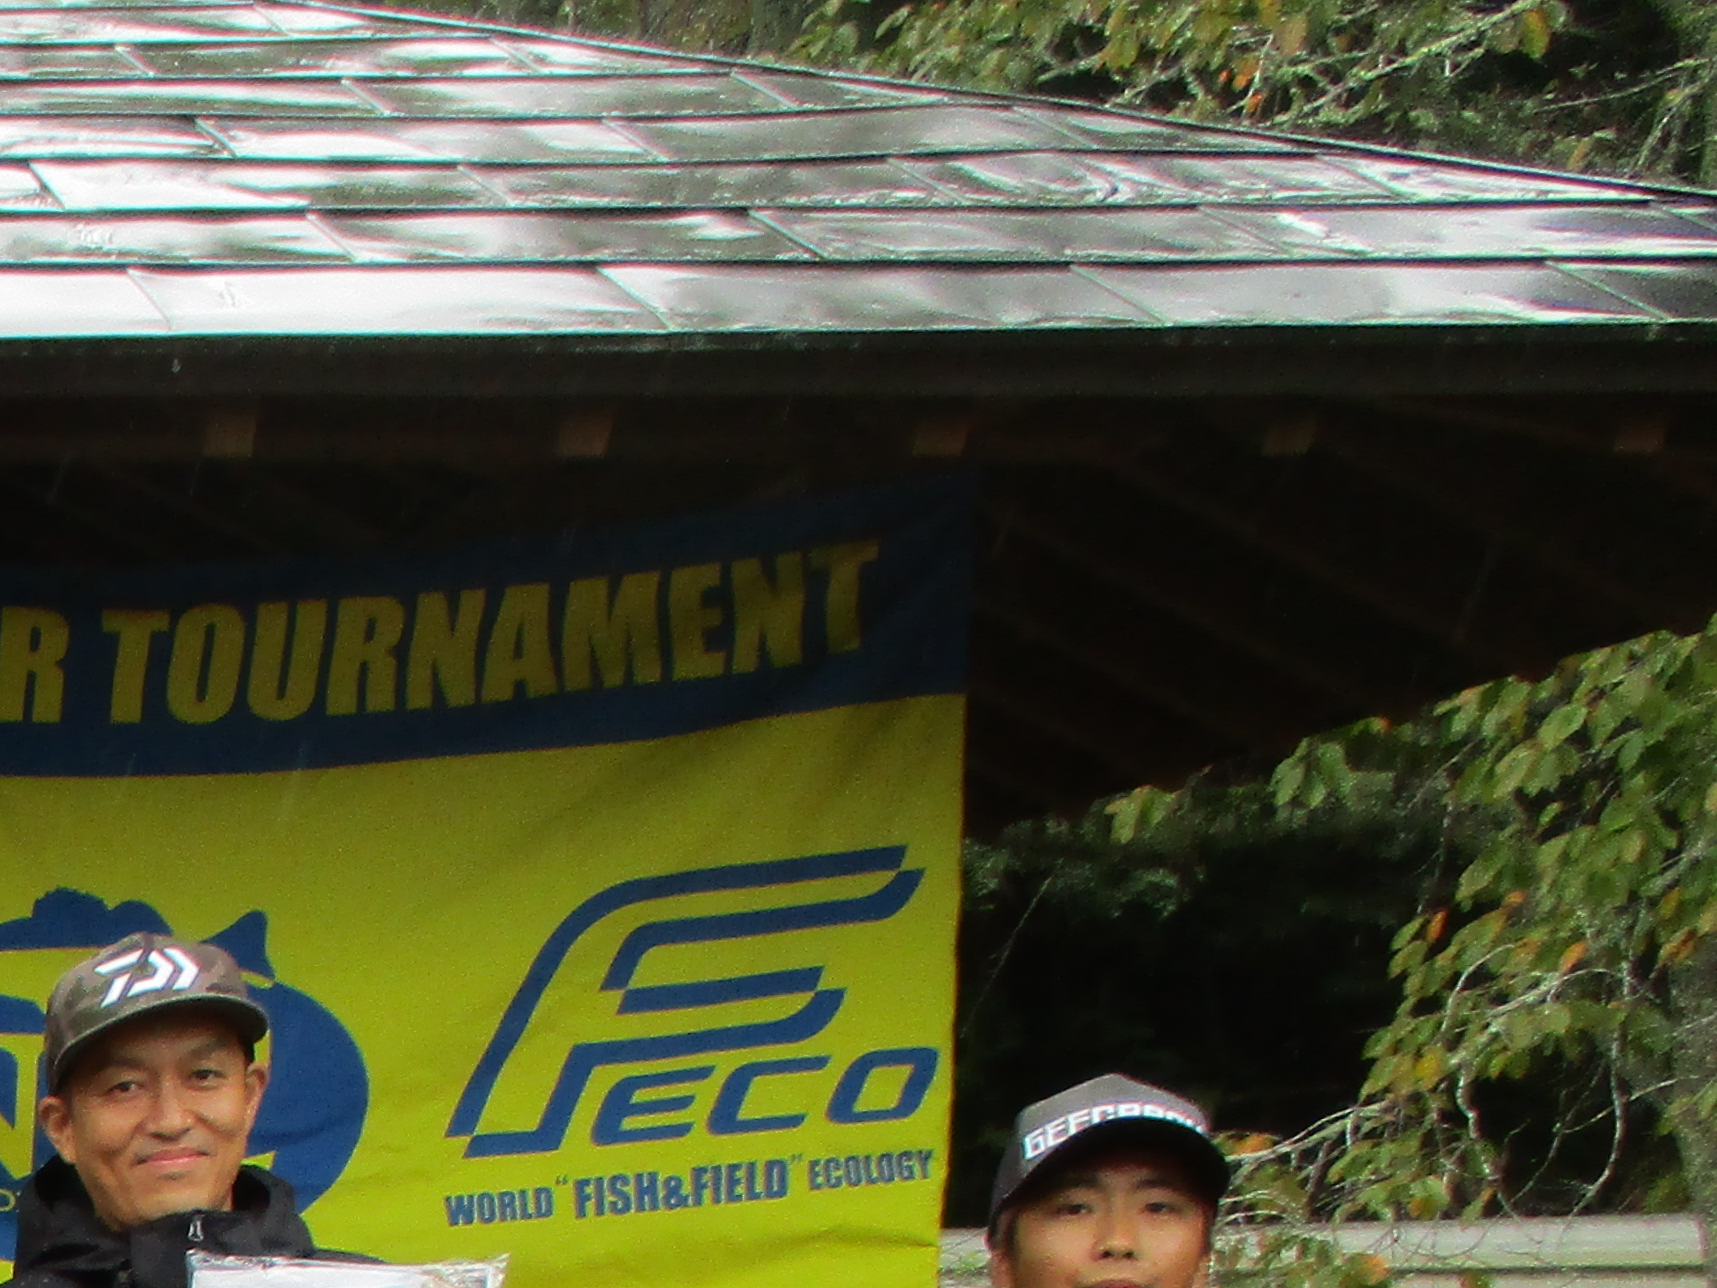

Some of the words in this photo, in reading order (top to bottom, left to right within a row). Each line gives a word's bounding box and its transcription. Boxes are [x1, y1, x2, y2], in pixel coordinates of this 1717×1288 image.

[102, 539, 878, 727] TOURNAMENT
[445, 1187, 553, 1227] WORLD
[808, 1150, 935, 1191] ECOLOGY
